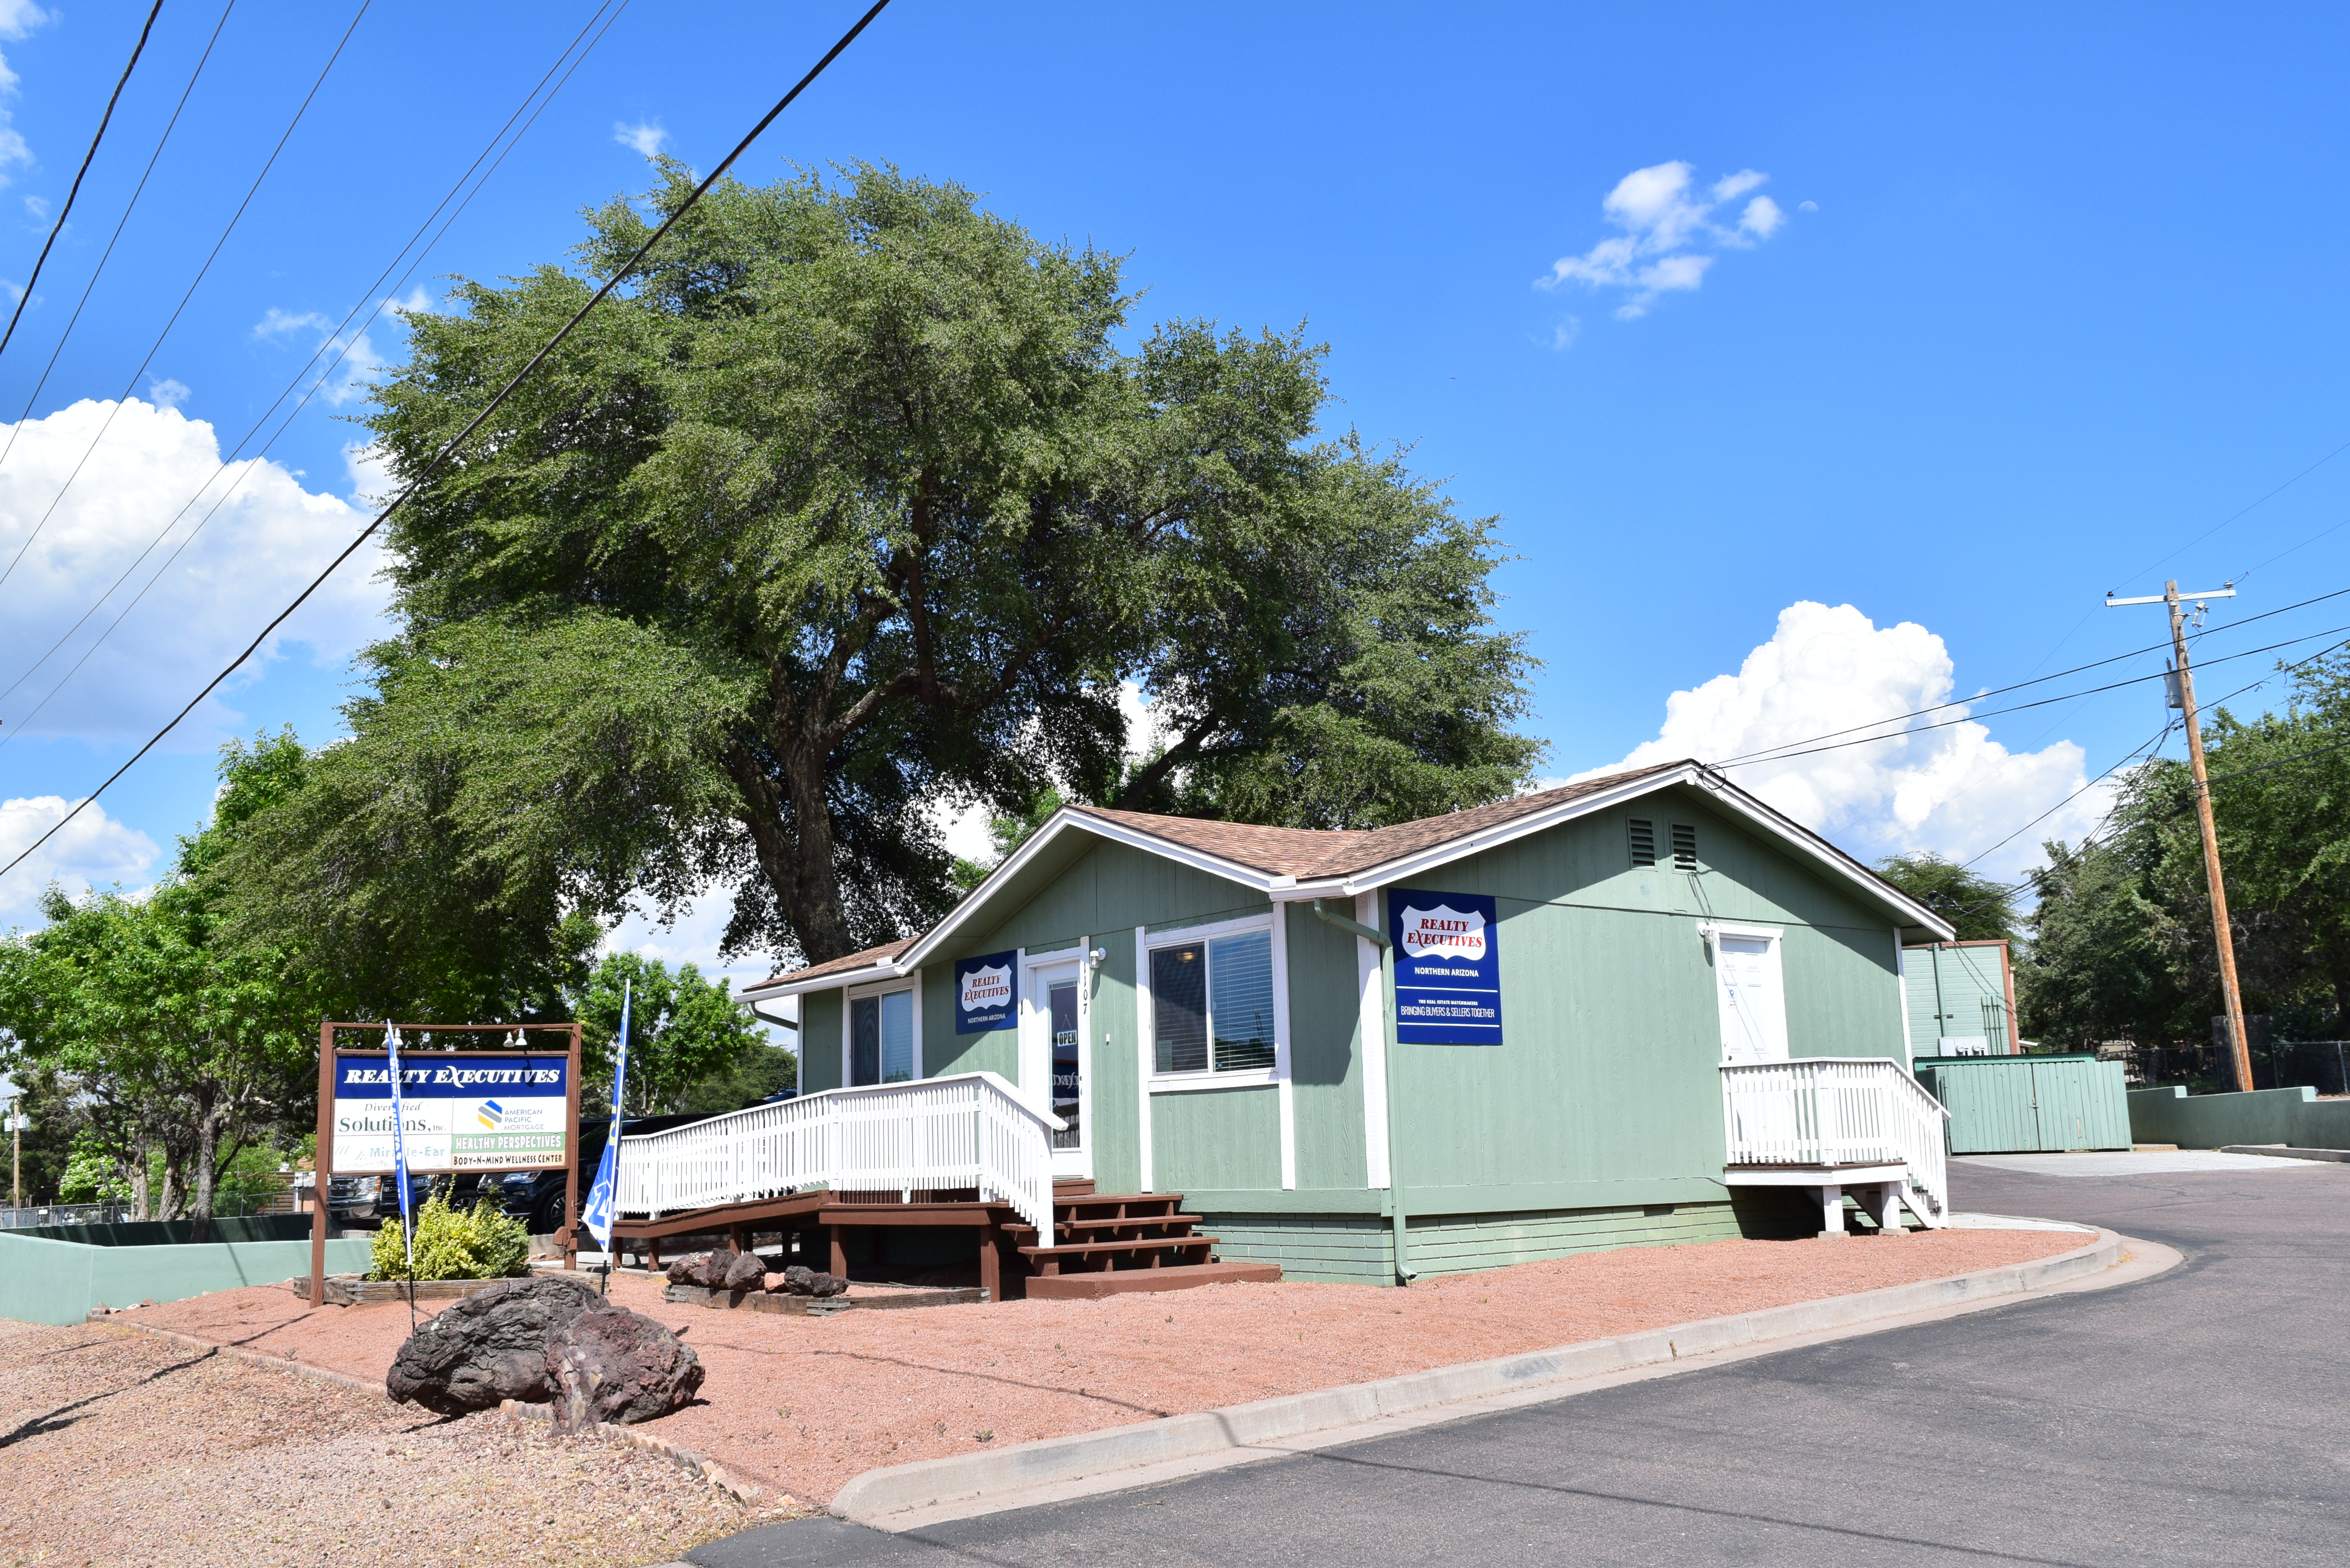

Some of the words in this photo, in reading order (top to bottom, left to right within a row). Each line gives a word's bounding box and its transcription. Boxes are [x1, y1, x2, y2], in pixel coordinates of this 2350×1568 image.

[1420, 918, 1469, 932] REALTY
[1406, 929, 1482, 948] EXECUTIVES
[1414, 967, 1450, 976] NORTHERN
[1451, 968, 1479, 977] ARIZONA
[972, 975, 1001, 988] REALTY
[964, 986, 1009, 1003] EXECUTIVES
[1401, 1006, 1425, 1016] BRINGING
[1426, 1007, 1446, 1016] BUYERS
[1446, 1007, 1450, 1016] &
[1451, 1008, 1470, 1017] SELLERS
[1471, 1008, 1495, 1018] TOGETHER
[967, 1016, 988, 1024] NORTHERN
[1059, 1031, 1076, 1045] OPEN
[432, 1065, 560, 1088] EXECUTIVES
[365, 1101, 423, 1113] Diverfied
[339, 1116, 431, 1133] Solutins,
[456, 1136, 496, 1150] HEALTHY
[498, 1135, 561, 1149] PERSPECTIVES
[505, 1155, 536, 1164] WELLNESS
[538, 1154, 562, 1162] CENTER
